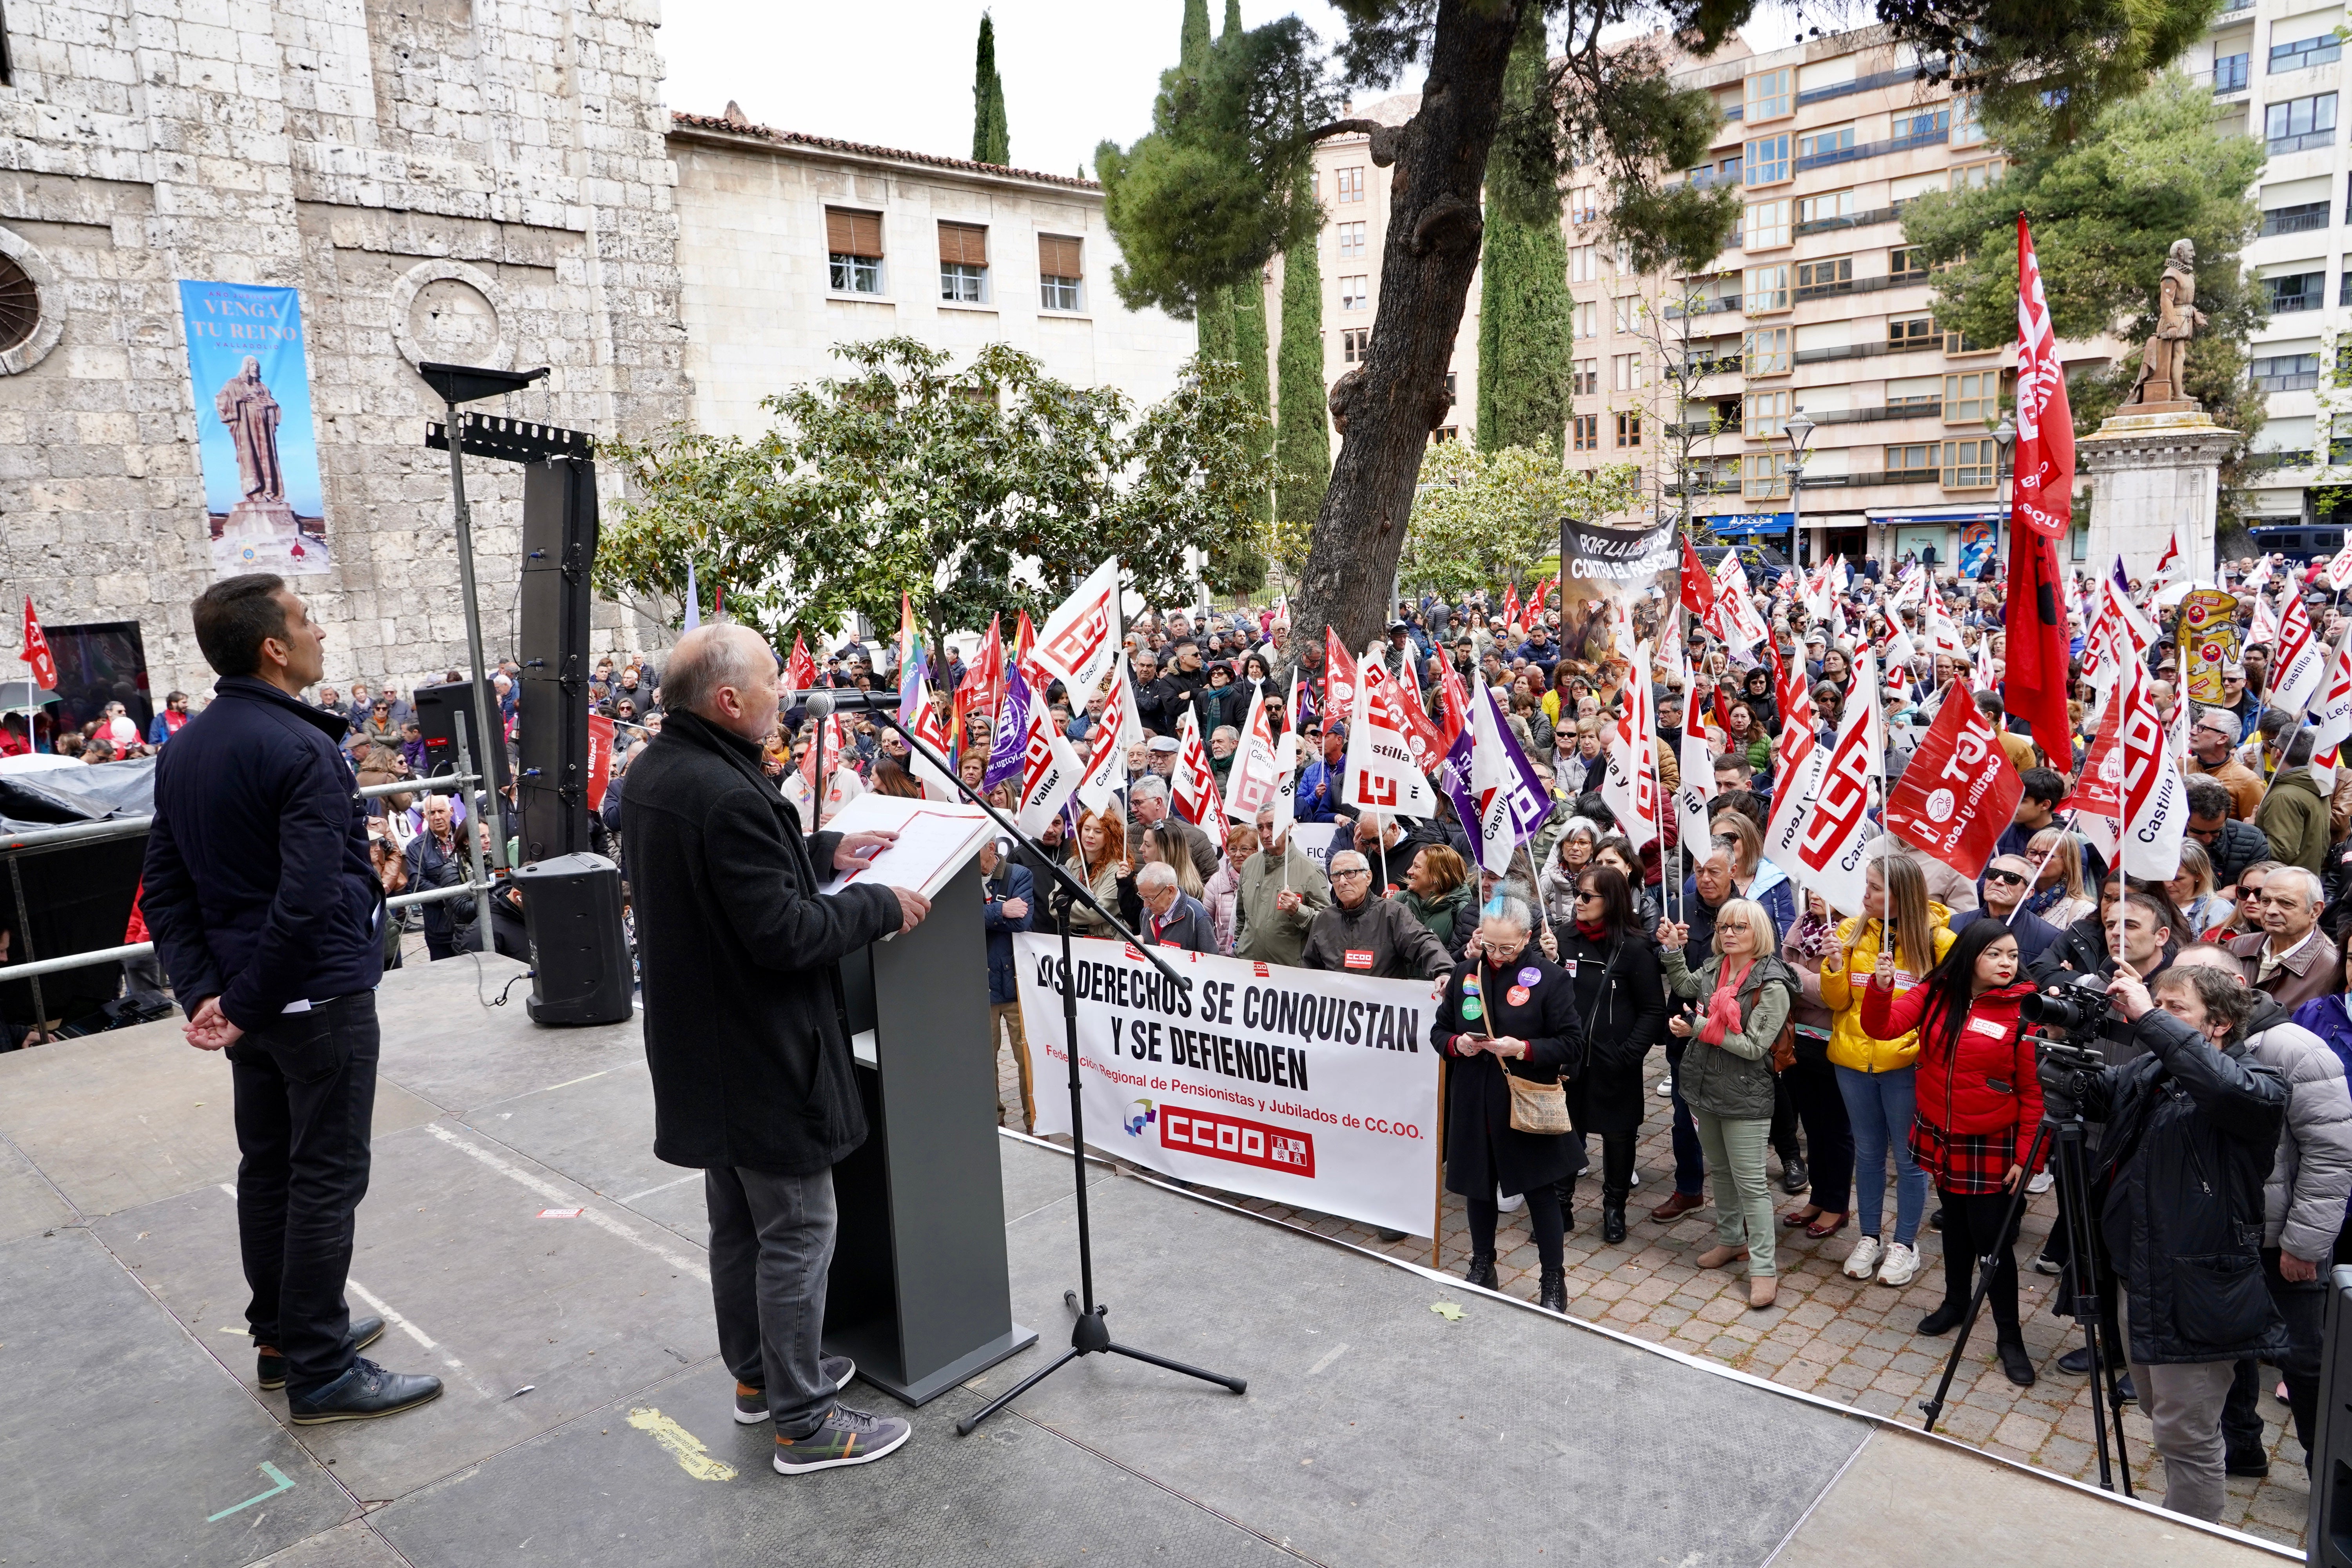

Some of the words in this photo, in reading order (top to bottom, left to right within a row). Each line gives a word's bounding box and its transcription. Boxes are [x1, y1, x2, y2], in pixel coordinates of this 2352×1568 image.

[203, 299, 280, 319] VENGA
[191, 321, 222, 337] TU
[230, 323, 297, 341] REINO
[216, 341, 279, 350] VALLADOLID
[1580, 534, 1609, 555] POR
[1604, 541, 1628, 557] LA
[1571, 558, 1616, 579] CONTRA
[1611, 561, 1632, 579] EL
[1628, 549, 1679, 578] FASCISMO
[2281, 558, 2305, 569] CIA
[1886, 643, 1897, 656] eón
[2283, 656, 2311, 691] Castilla
[1371, 743, 1410, 763] stilla
[1096, 751, 1117, 787] Castilla
[1031, 768, 1060, 807] Vallad
[1281, 780, 1295, 797] Se
[2138, 778, 2174, 843] Castilla
[2168, 762, 2177, 778] y
[1347, 953, 1372, 961] CCOO
[1076, 959, 1192, 1018] DERECHOS
[1201, 980, 1234, 1025] SE
[1244, 985, 1418, 1053] CONQUISTAN
[1976, 1021, 2001, 1032] CCOO
[1111, 1016, 1123, 1055] Y
[1131, 1020, 1162, 1063] SE
[1170, 1027, 1308, 1091] DEFIENDEN
[1046, 1044, 1099, 1071] Fedeación
[1100, 1063, 1147, 1088] Regional
[1151, 1075, 1168, 1091] de
[1171, 1080, 1256, 1108] Pensionistas
[1259, 1100, 1266, 1112] y
[1269, 1099, 1339, 1124] Jubilados
[1341, 1112, 1361, 1128] de
[1364, 1117, 1425, 1140] CC.OO.
[1167, 1114, 1265, 1158] CCOO
